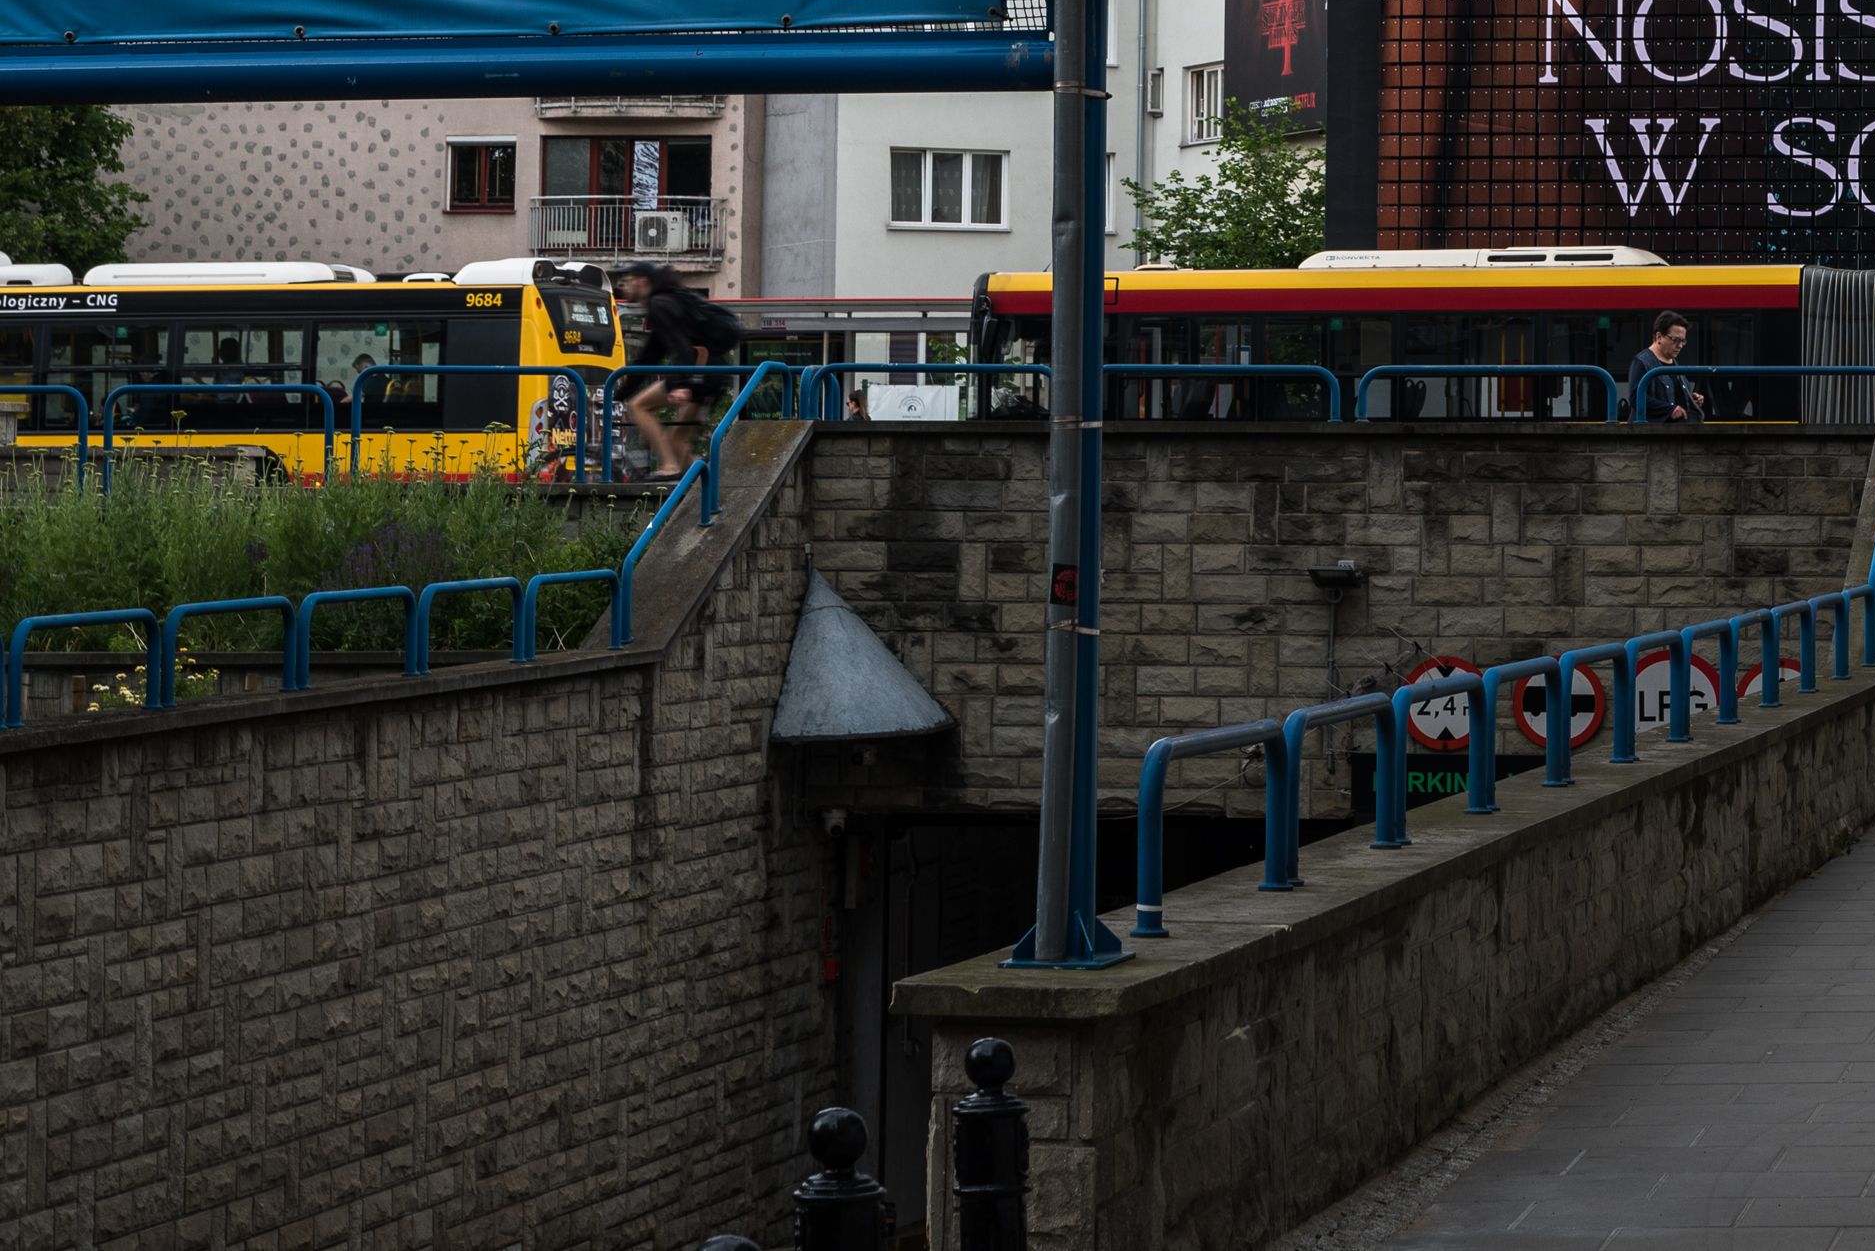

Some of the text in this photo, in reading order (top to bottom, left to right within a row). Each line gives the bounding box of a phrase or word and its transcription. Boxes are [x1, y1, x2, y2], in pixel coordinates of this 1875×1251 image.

[1584, 118, 1721, 217] W
[0, 294, 118, 310] logiczny CNG
[466, 293, 502, 307] 9684
